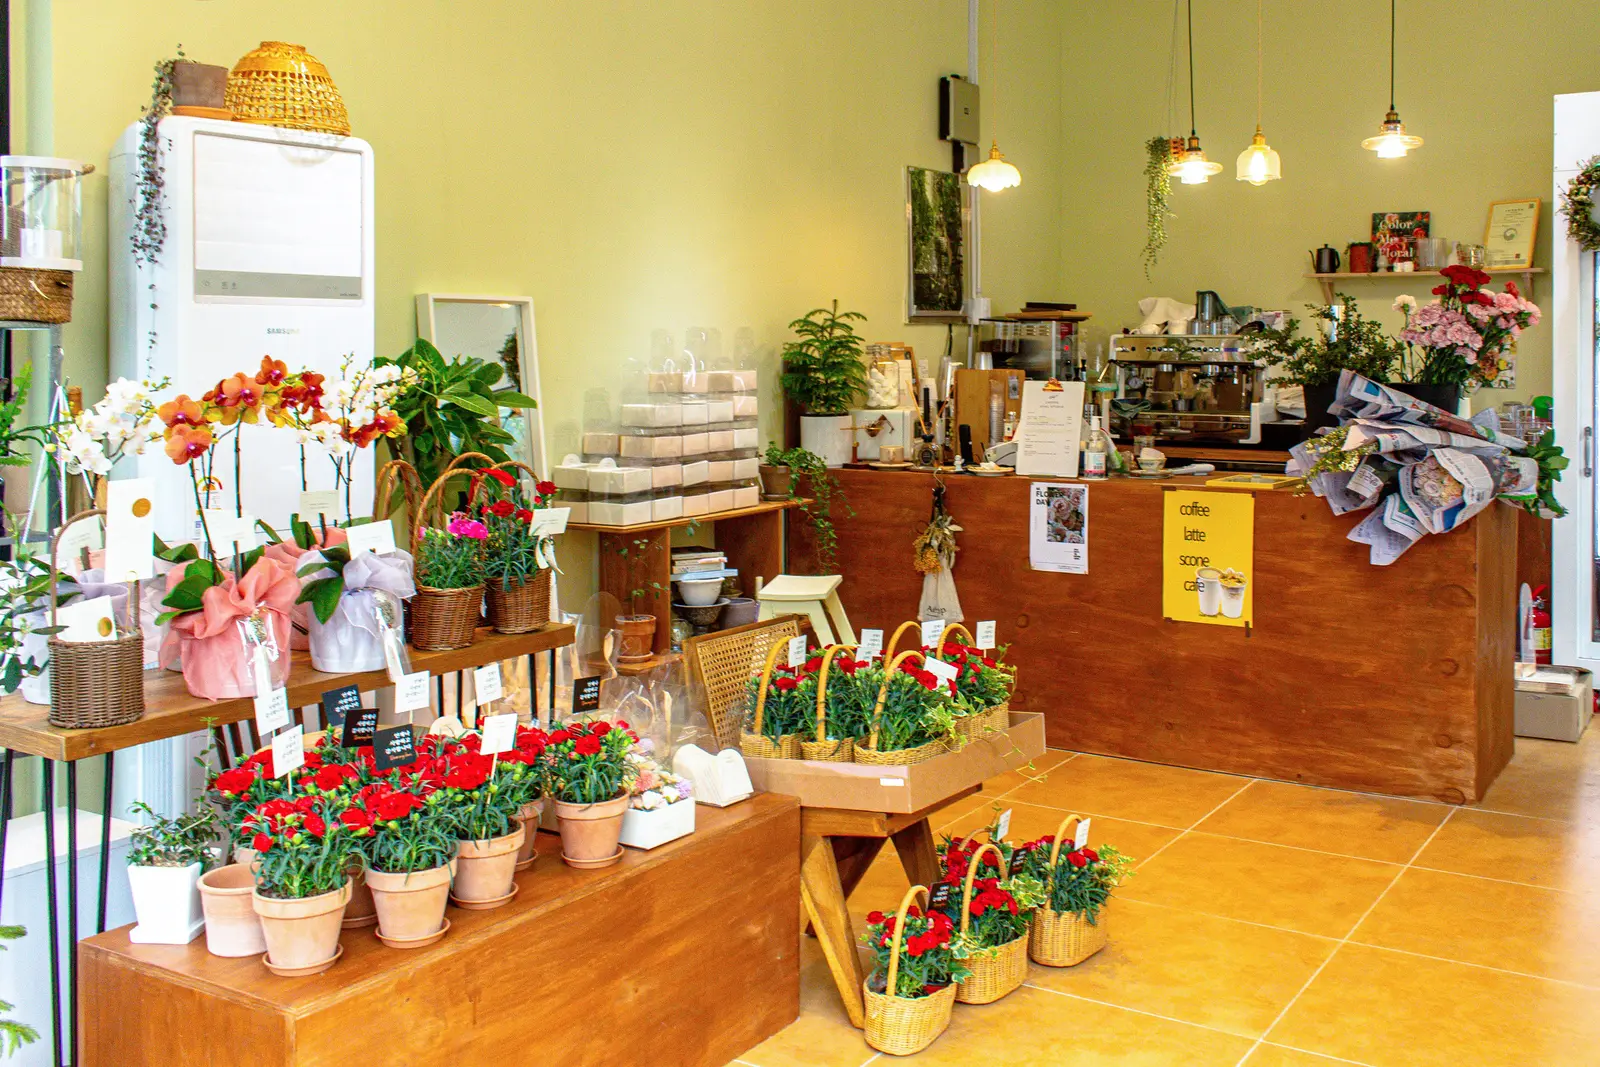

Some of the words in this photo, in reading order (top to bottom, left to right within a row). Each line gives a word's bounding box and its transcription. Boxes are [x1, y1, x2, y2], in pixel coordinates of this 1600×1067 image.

[1379, 219, 1413, 230] Color
[1378, 246, 1414, 258] Floral
[1036, 498, 1050, 506] DAY
[1179, 501, 1210, 517] coffee
[1184, 525, 1206, 542] latte
[1179, 554, 1210, 568] scone
[1183, 577, 1205, 593] cafe
